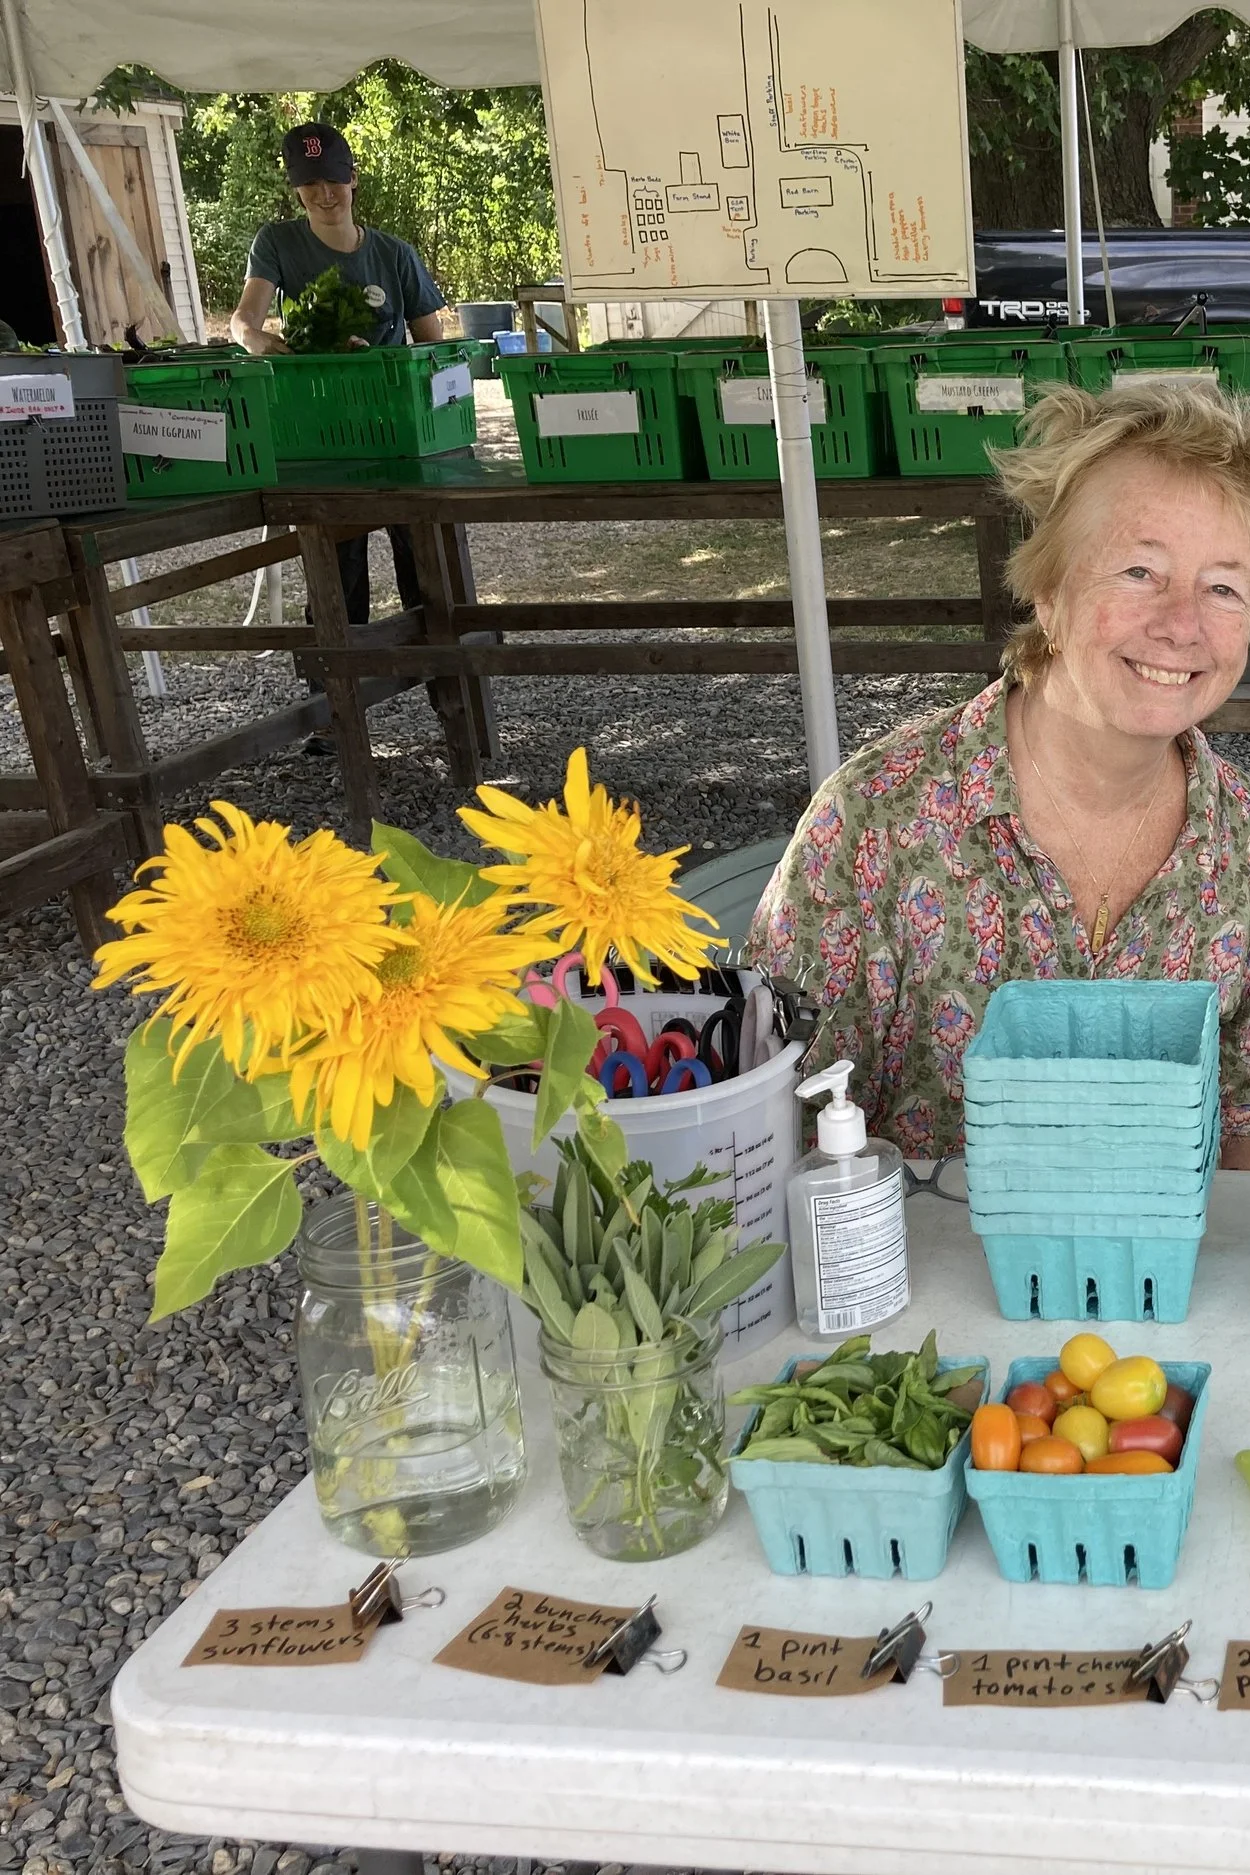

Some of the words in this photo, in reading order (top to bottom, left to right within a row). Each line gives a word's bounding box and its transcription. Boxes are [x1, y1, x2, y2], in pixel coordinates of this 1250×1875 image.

[303, 136, 322, 157] B
[672, 193, 689, 201] Farm
[795, 209, 819, 218] Parking
[979, 300, 1046, 321] TRD
[12, 387, 56, 402] WATERMELON
[941, 384, 971, 396] MUSTARD
[973, 384, 999, 396] GREENS
[133, 422, 158, 436] ASIAN
[162, 426, 201, 439] EGGPLANT
[313, 1361, 425, 1425] Ball
[504, 1592, 524, 1611] 2
[219, 1618, 240, 1638] 3
[250, 1614, 335, 1636] stems
[504, 1610, 577, 1638] herbs
[201, 1631, 365, 1661] sunflowers
[521, 1634, 595, 1665] stems)
[742, 1631, 762, 1649] 1
[781, 1638, 844, 1661] pint
[754, 1658, 839, 1686] basil
[971, 1653, 992, 1672] 1
[972, 1675, 1116, 1697] tomatoes
